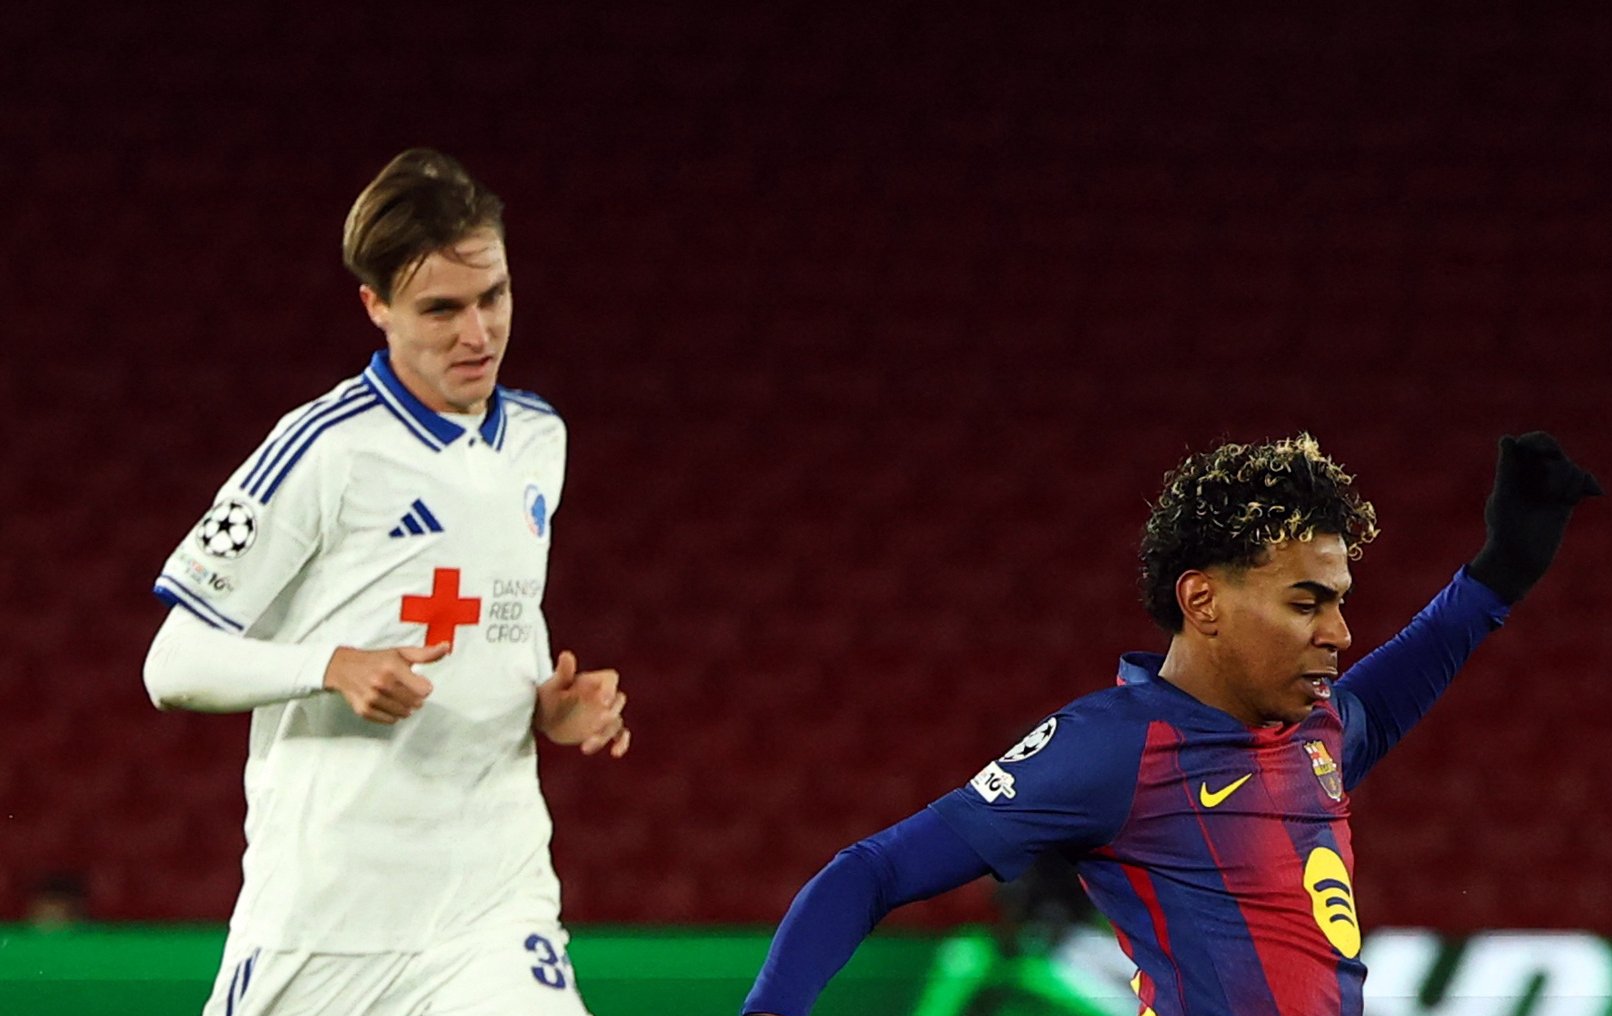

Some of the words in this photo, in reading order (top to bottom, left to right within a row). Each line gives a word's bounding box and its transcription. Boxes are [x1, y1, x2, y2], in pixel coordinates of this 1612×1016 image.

[488, 601, 523, 620] RED
[486, 623, 532, 643] CROS
[524, 933, 569, 990] 3
